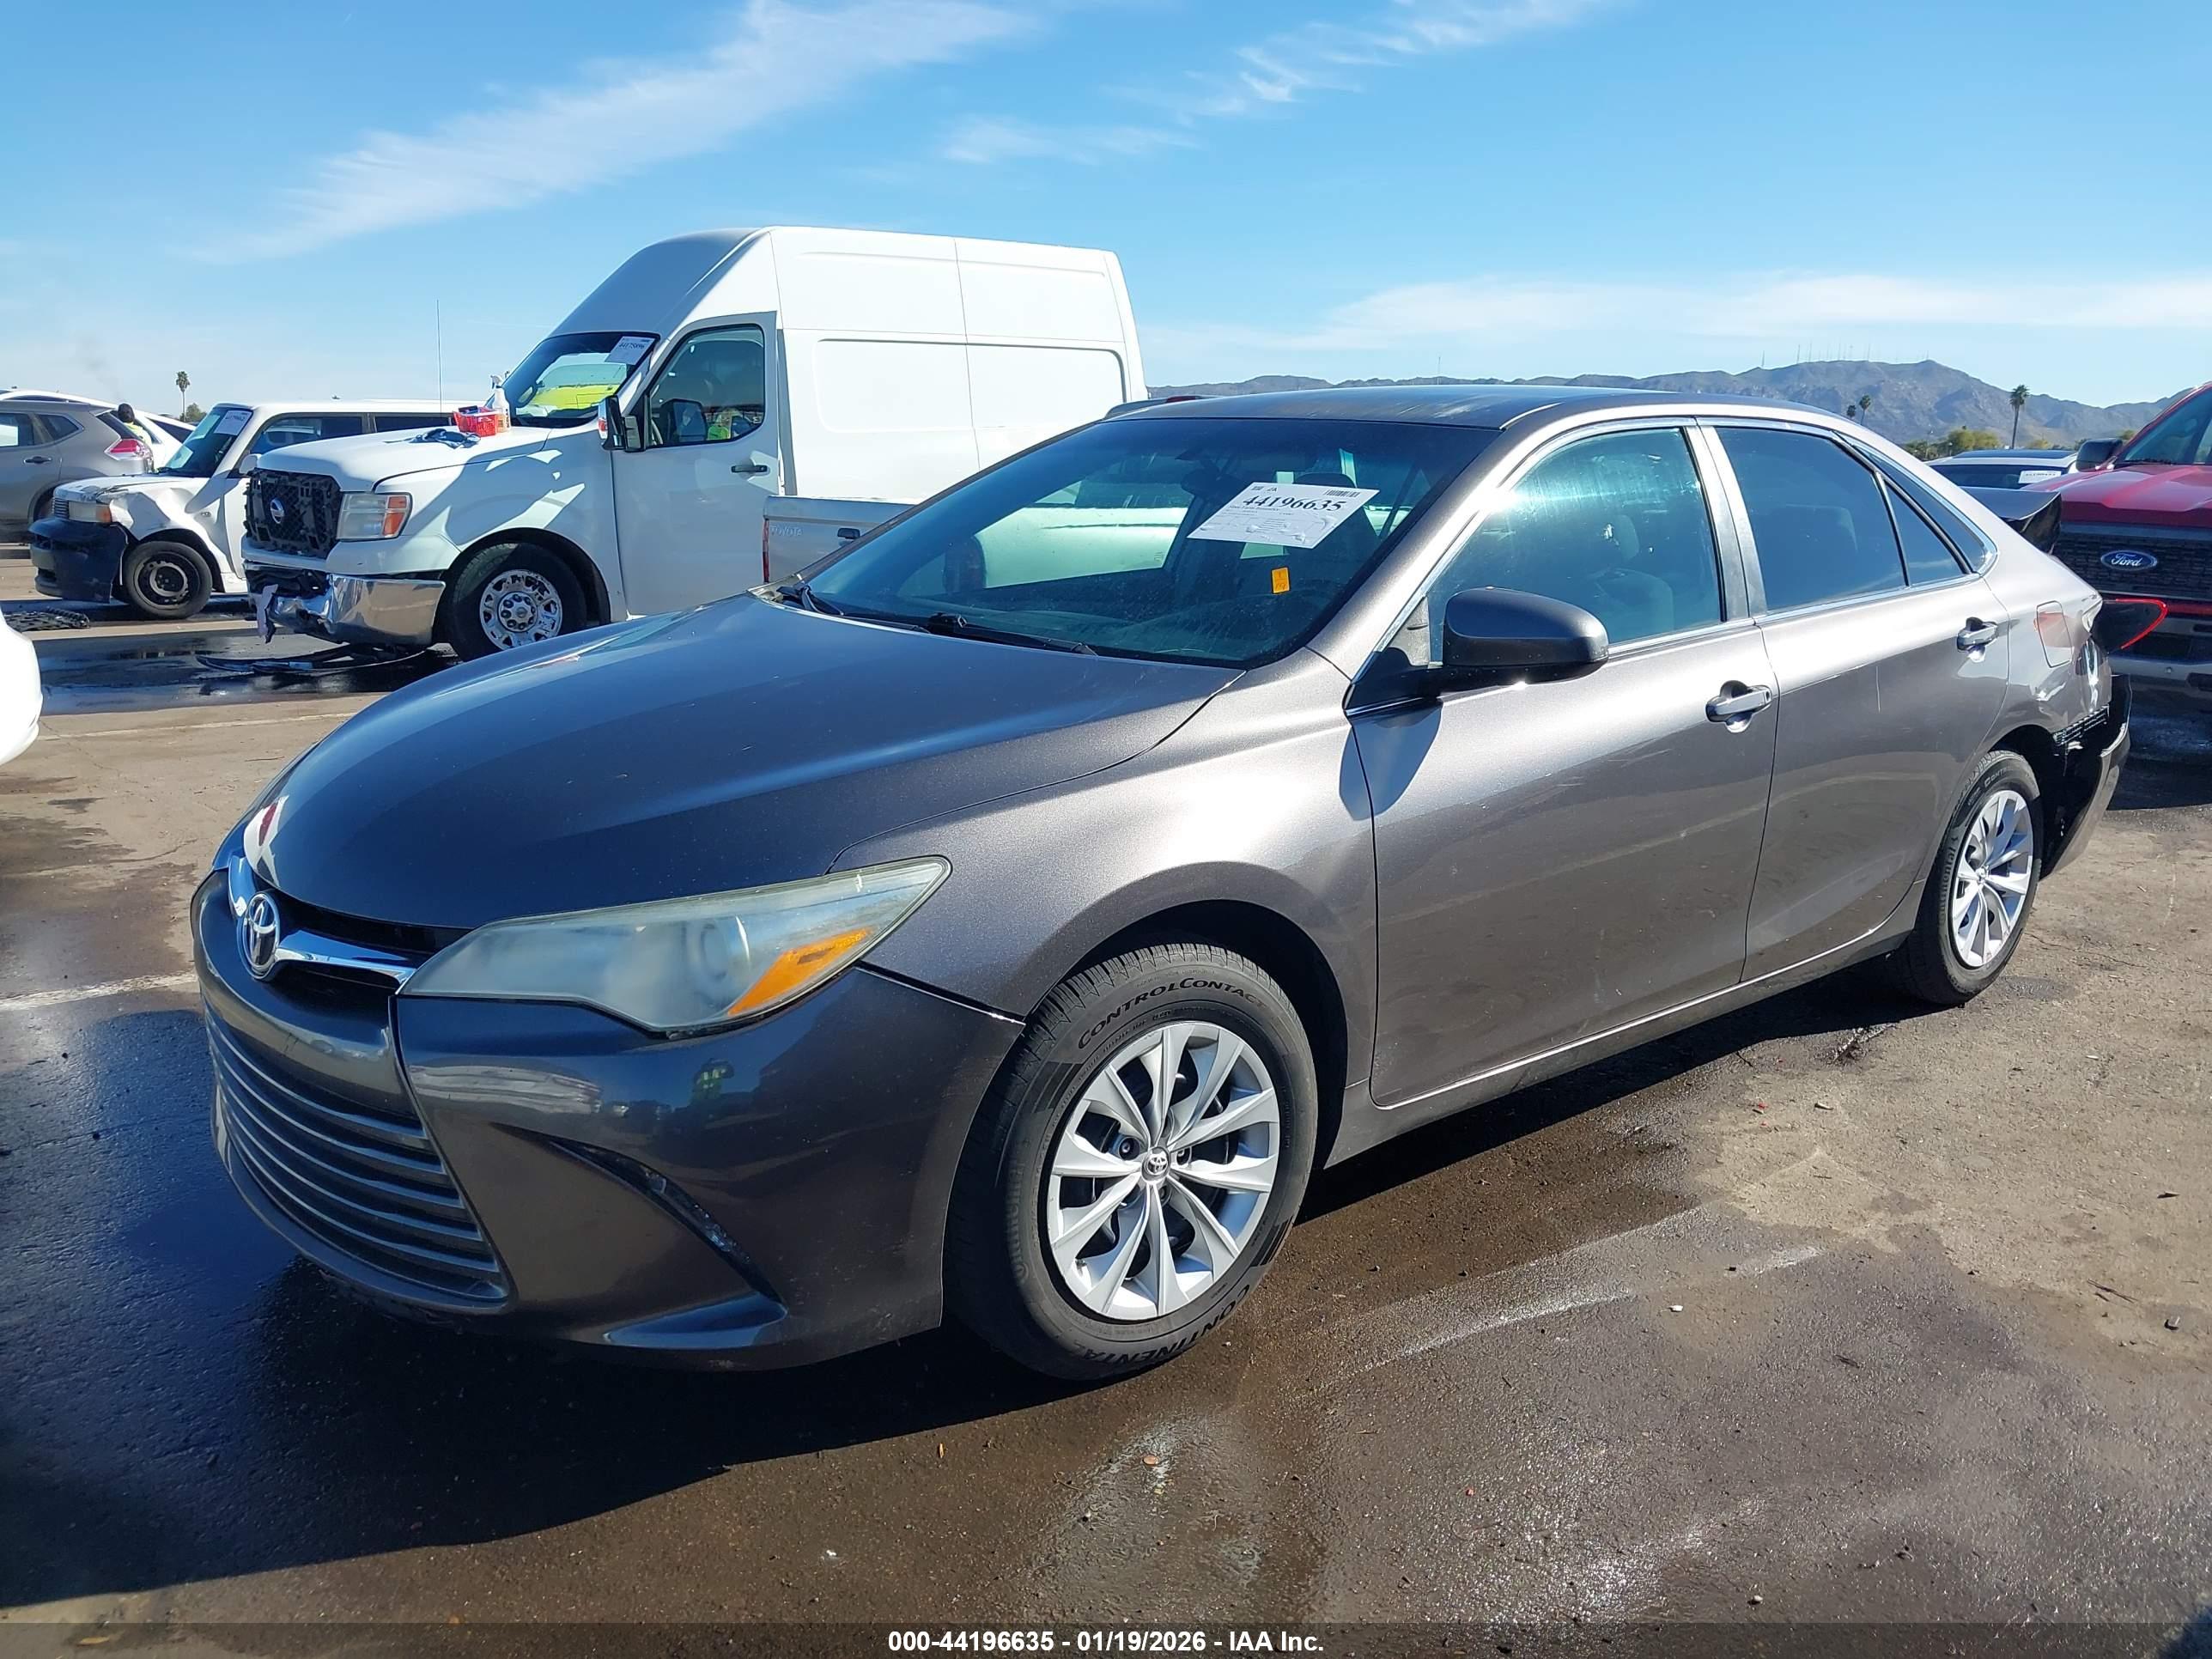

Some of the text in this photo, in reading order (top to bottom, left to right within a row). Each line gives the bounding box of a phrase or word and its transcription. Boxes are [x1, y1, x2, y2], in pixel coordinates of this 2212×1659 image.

[1243, 495, 1346, 511] 44196635
[769, 525, 804, 537] TOYOTA
[2112, 552, 2142, 567] Ford
